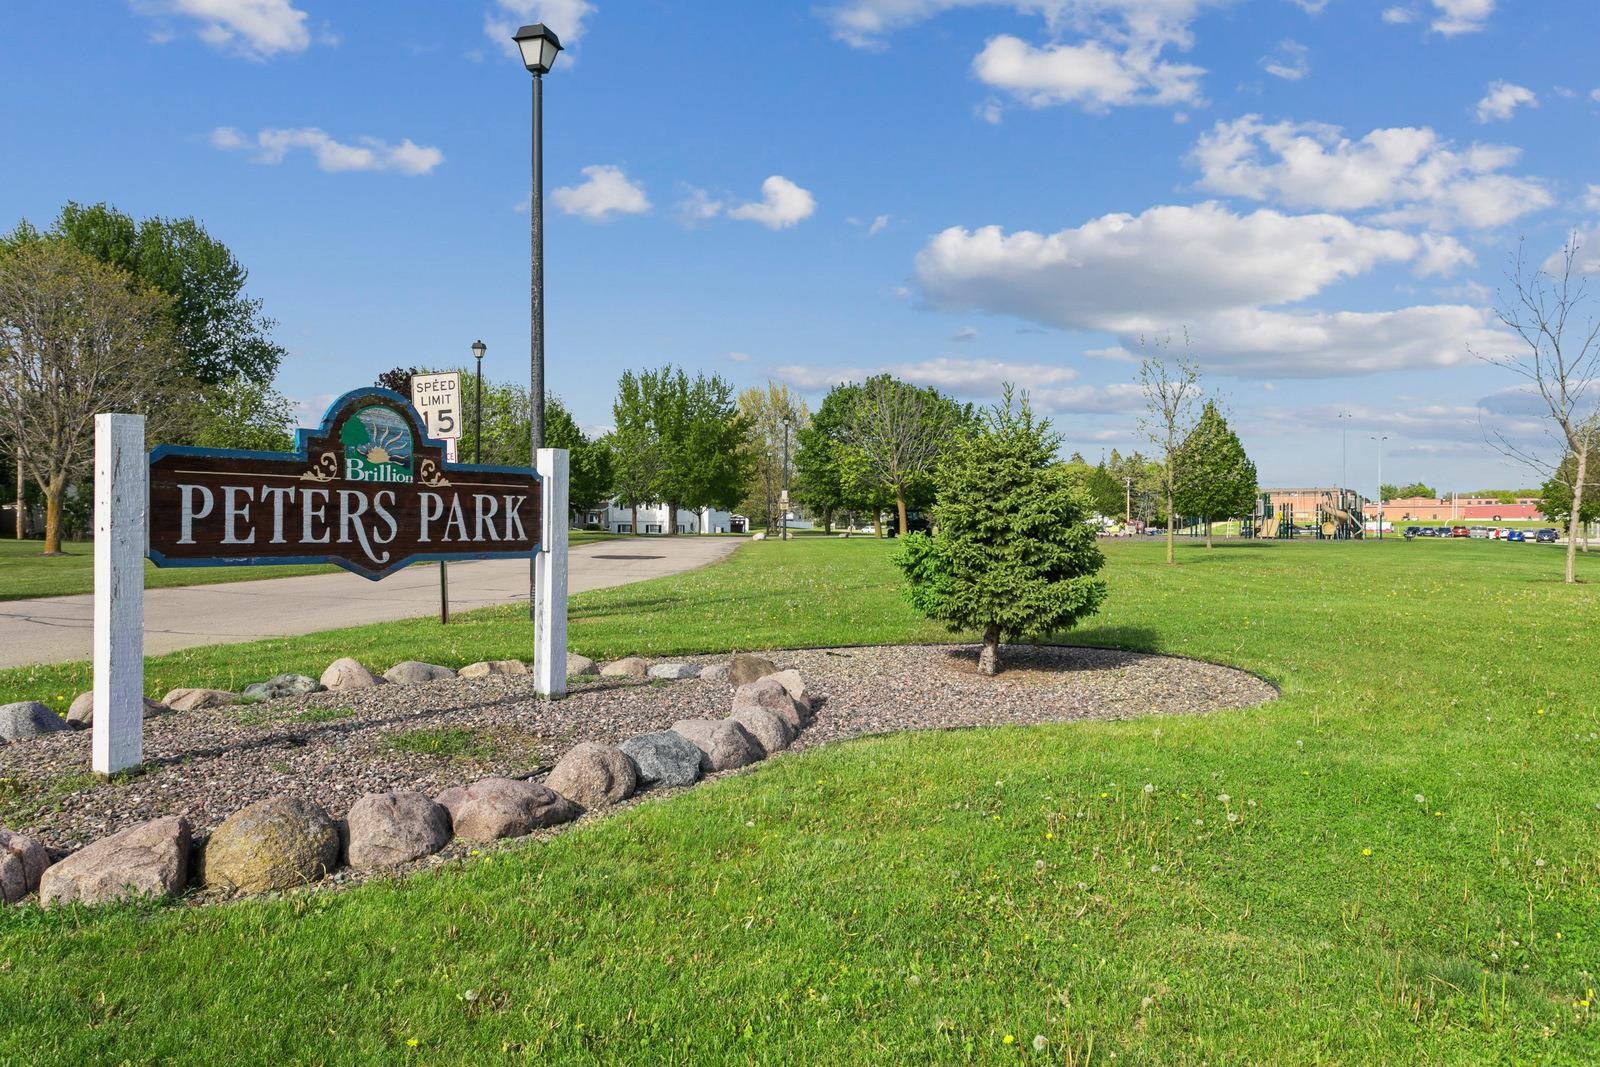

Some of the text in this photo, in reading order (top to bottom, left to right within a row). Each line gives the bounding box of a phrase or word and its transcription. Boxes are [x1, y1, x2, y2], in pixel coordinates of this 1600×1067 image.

[416, 380, 456, 393] SPEED
[421, 394, 451, 406] LIMIT
[423, 409, 454, 433] 15
[344, 457, 414, 483] Brillion
[176, 484, 528, 564] PETERS PARK
